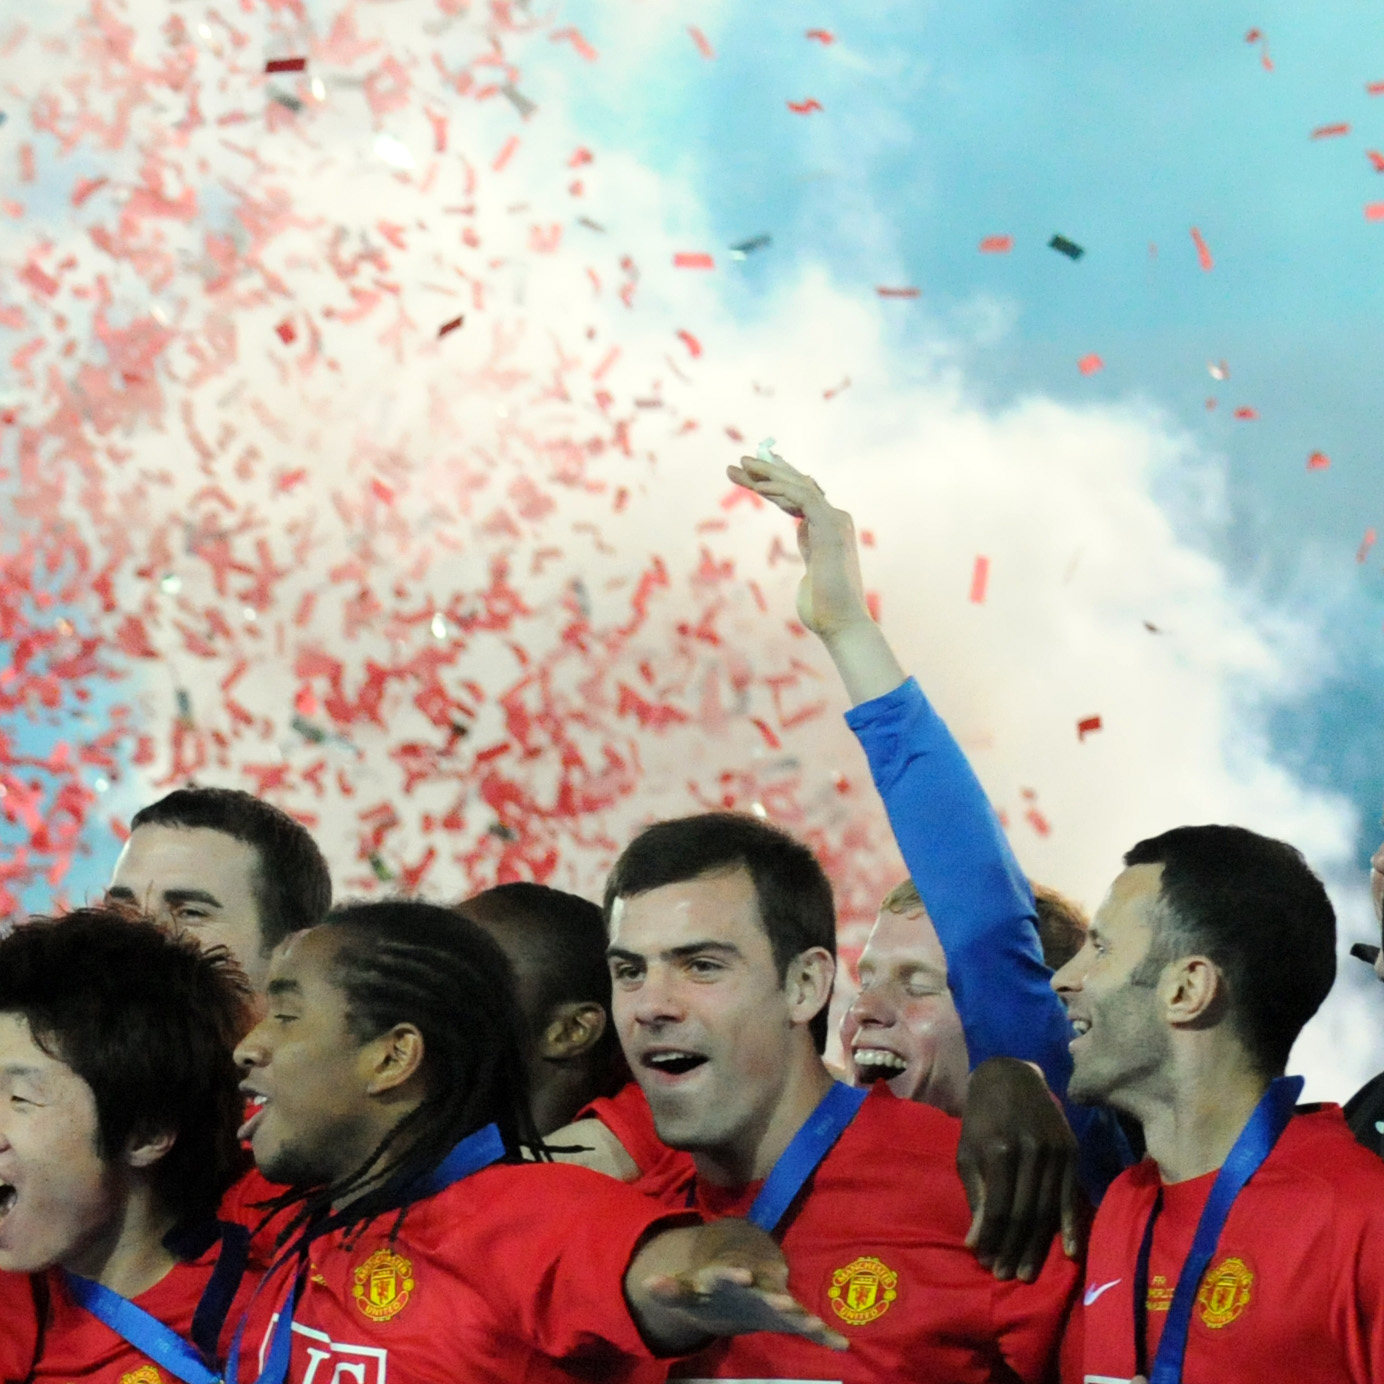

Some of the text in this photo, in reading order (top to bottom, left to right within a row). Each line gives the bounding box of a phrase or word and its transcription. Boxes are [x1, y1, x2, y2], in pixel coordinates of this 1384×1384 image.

[837, 1260, 894, 1285] MANCHESTER
[365, 1302, 401, 1317] UNITED
[839, 1306, 880, 1320] UNITED
